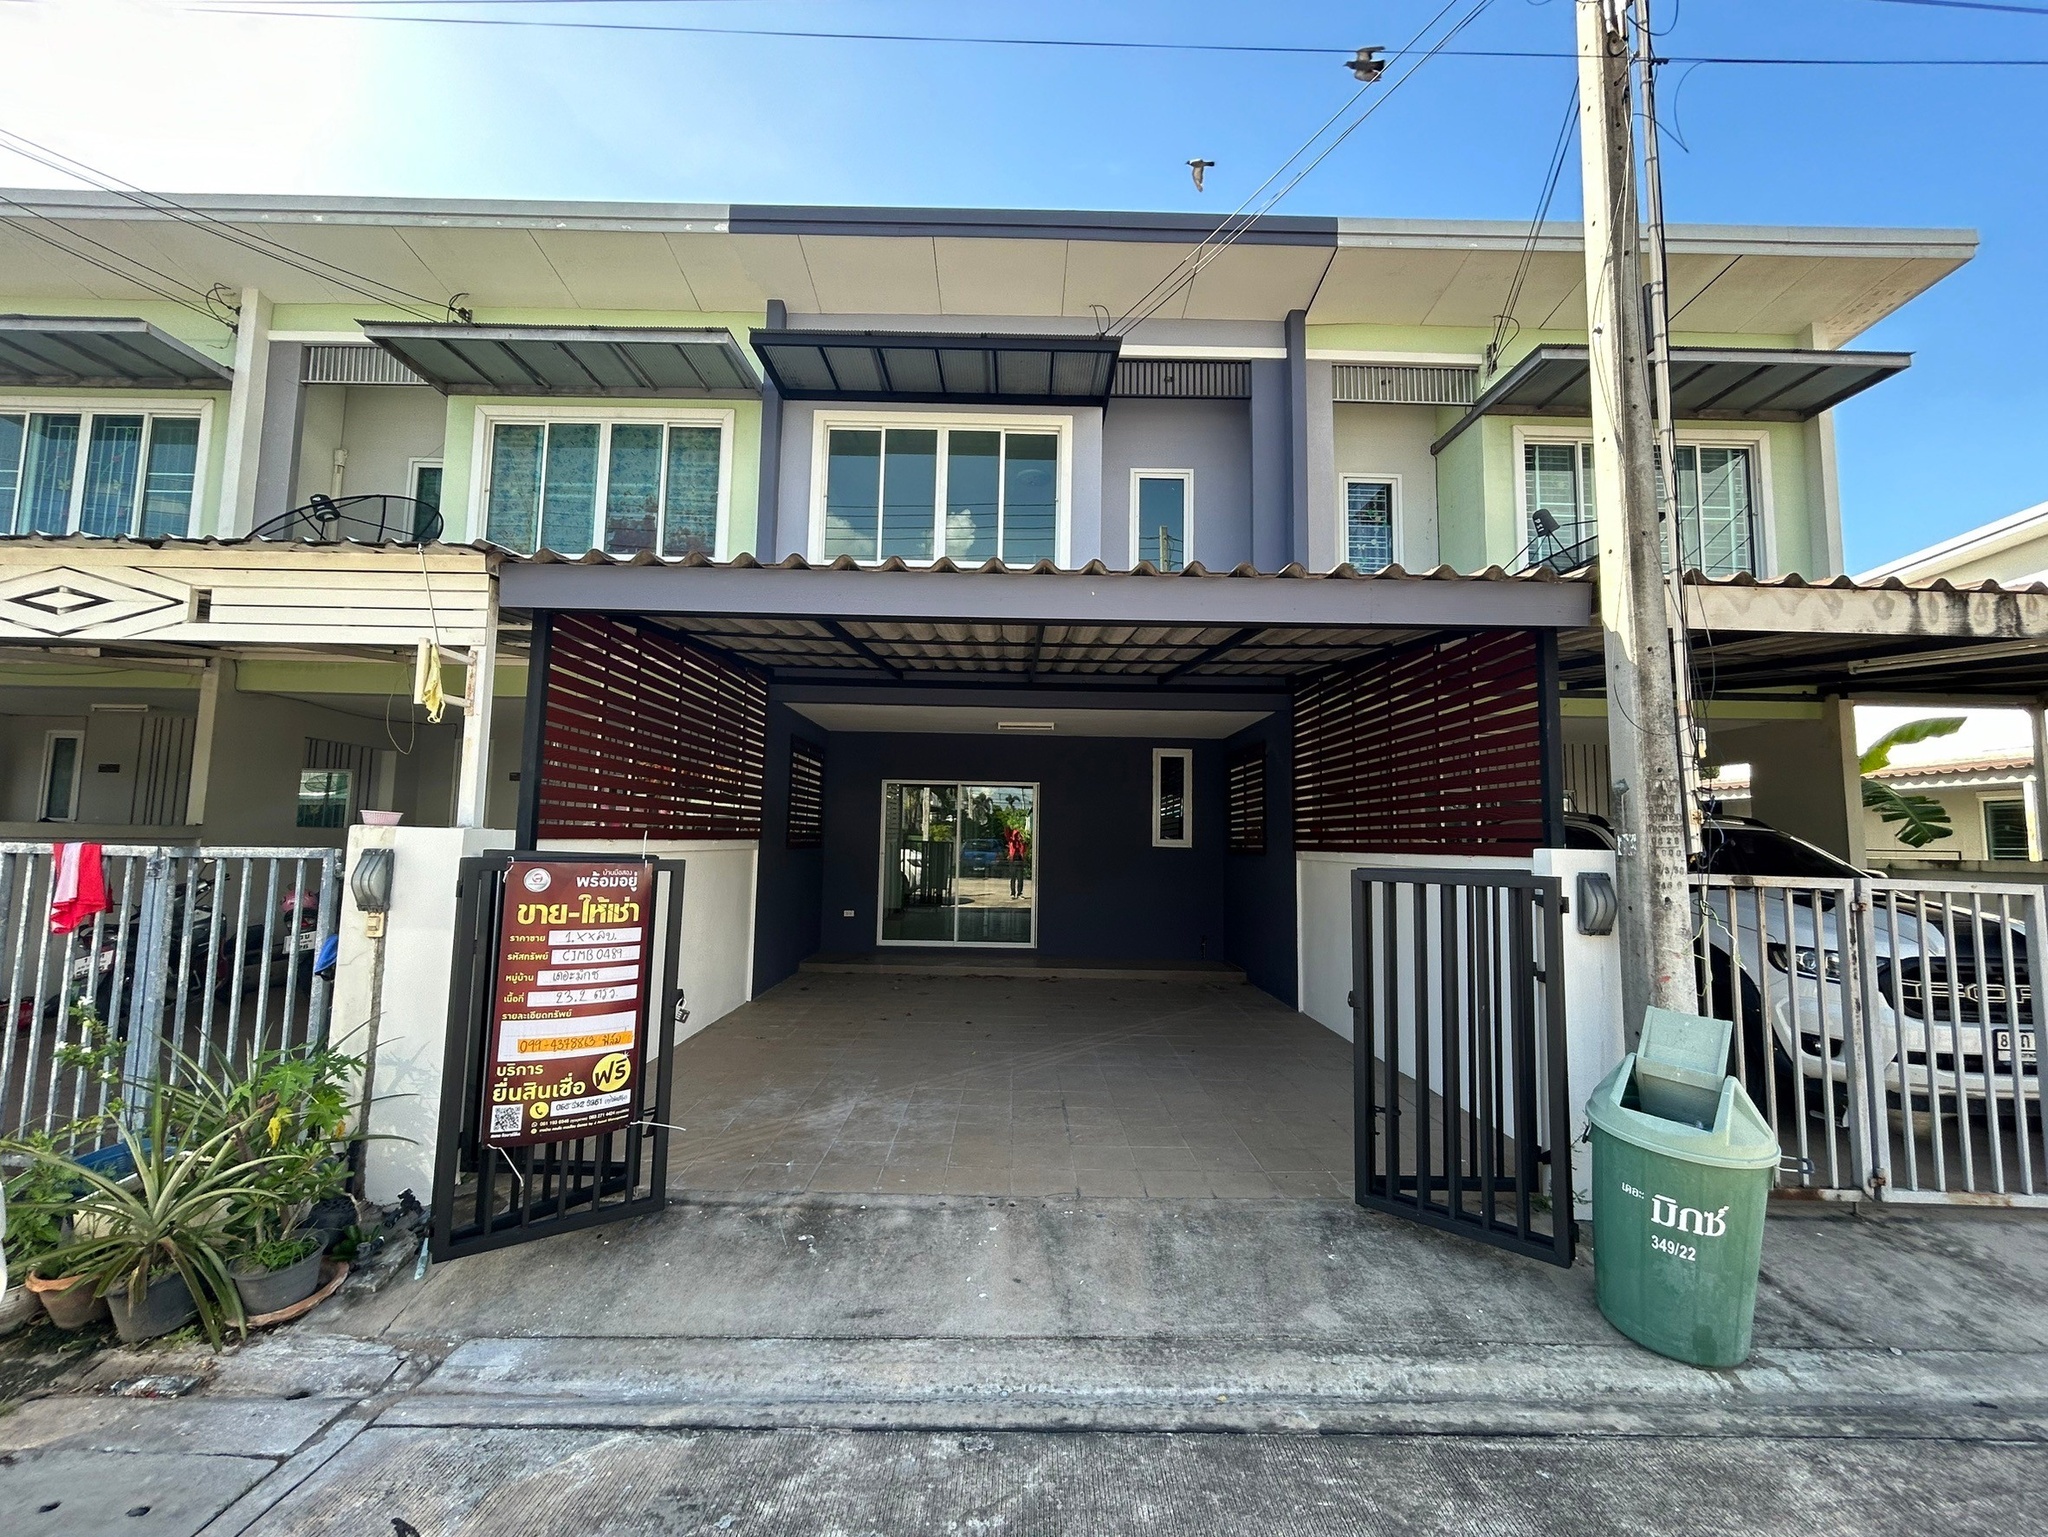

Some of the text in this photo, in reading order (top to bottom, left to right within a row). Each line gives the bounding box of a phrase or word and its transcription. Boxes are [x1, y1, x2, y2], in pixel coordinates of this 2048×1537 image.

[576, 870, 638, 892] พร้อมอยู่
[517, 893, 640, 925] ขาย-ให้เช่า
[509, 934, 546, 943] ราคาขาย
[506, 951, 549, 961] รหัสทรัพย์
[505, 972, 534, 984] หมู่บ้าน
[503, 991, 524, 1003] เนื้อที่
[502, 1008, 573, 1020] รายละเอียดทรัพย์
[496, 1062, 544, 1077] บริการ
[595, 1058, 627, 1087] ฟรี
[492, 1072, 586, 1103] ยื่นสินเชื่อ
[1650, 1193, 1730, 1237] มิกซ์
[1651, 1234, 1697, 1262] 349/22
